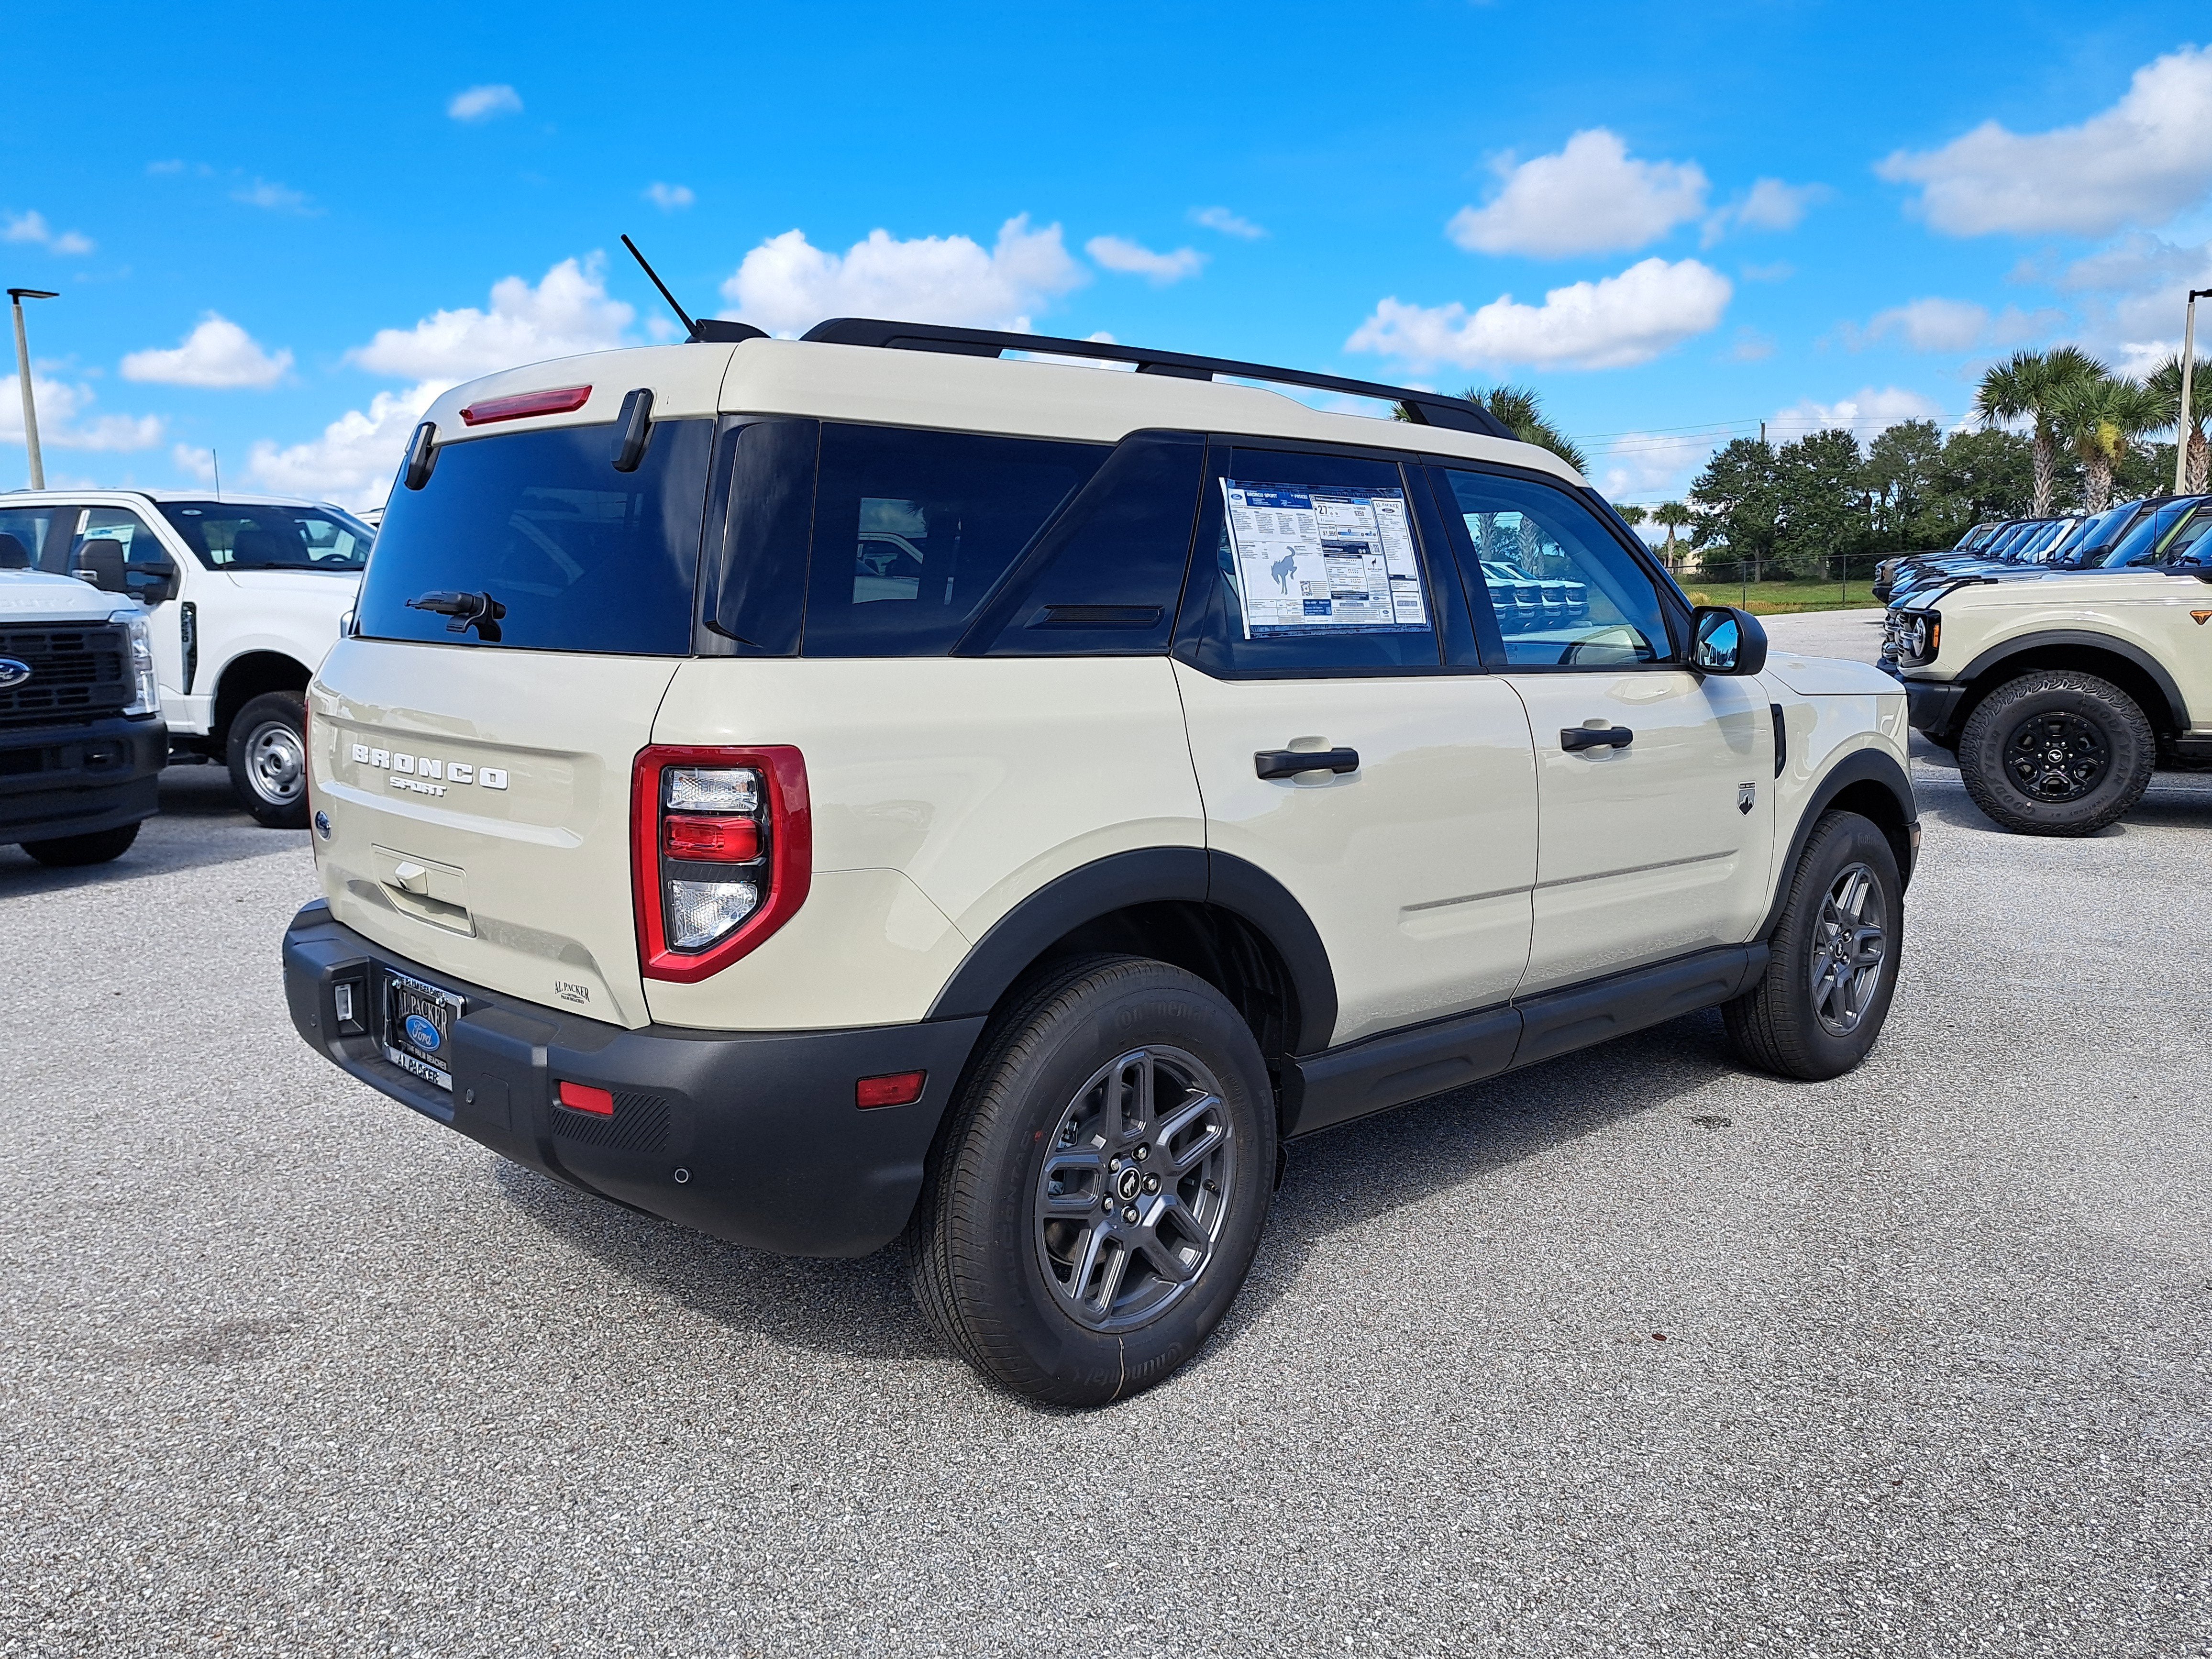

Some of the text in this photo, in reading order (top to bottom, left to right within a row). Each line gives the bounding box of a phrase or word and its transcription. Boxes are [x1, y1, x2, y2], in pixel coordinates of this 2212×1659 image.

[1318, 505, 1327, 515] 27
[352, 743, 509, 791] BRONCO
[388, 775, 448, 796] SPORT
[554, 981, 590, 1003] AL PACKER
[398, 990, 449, 1041] AL PACKER
[411, 1020, 434, 1047] Ford
[398, 1054, 440, 1084] AL PACKER
